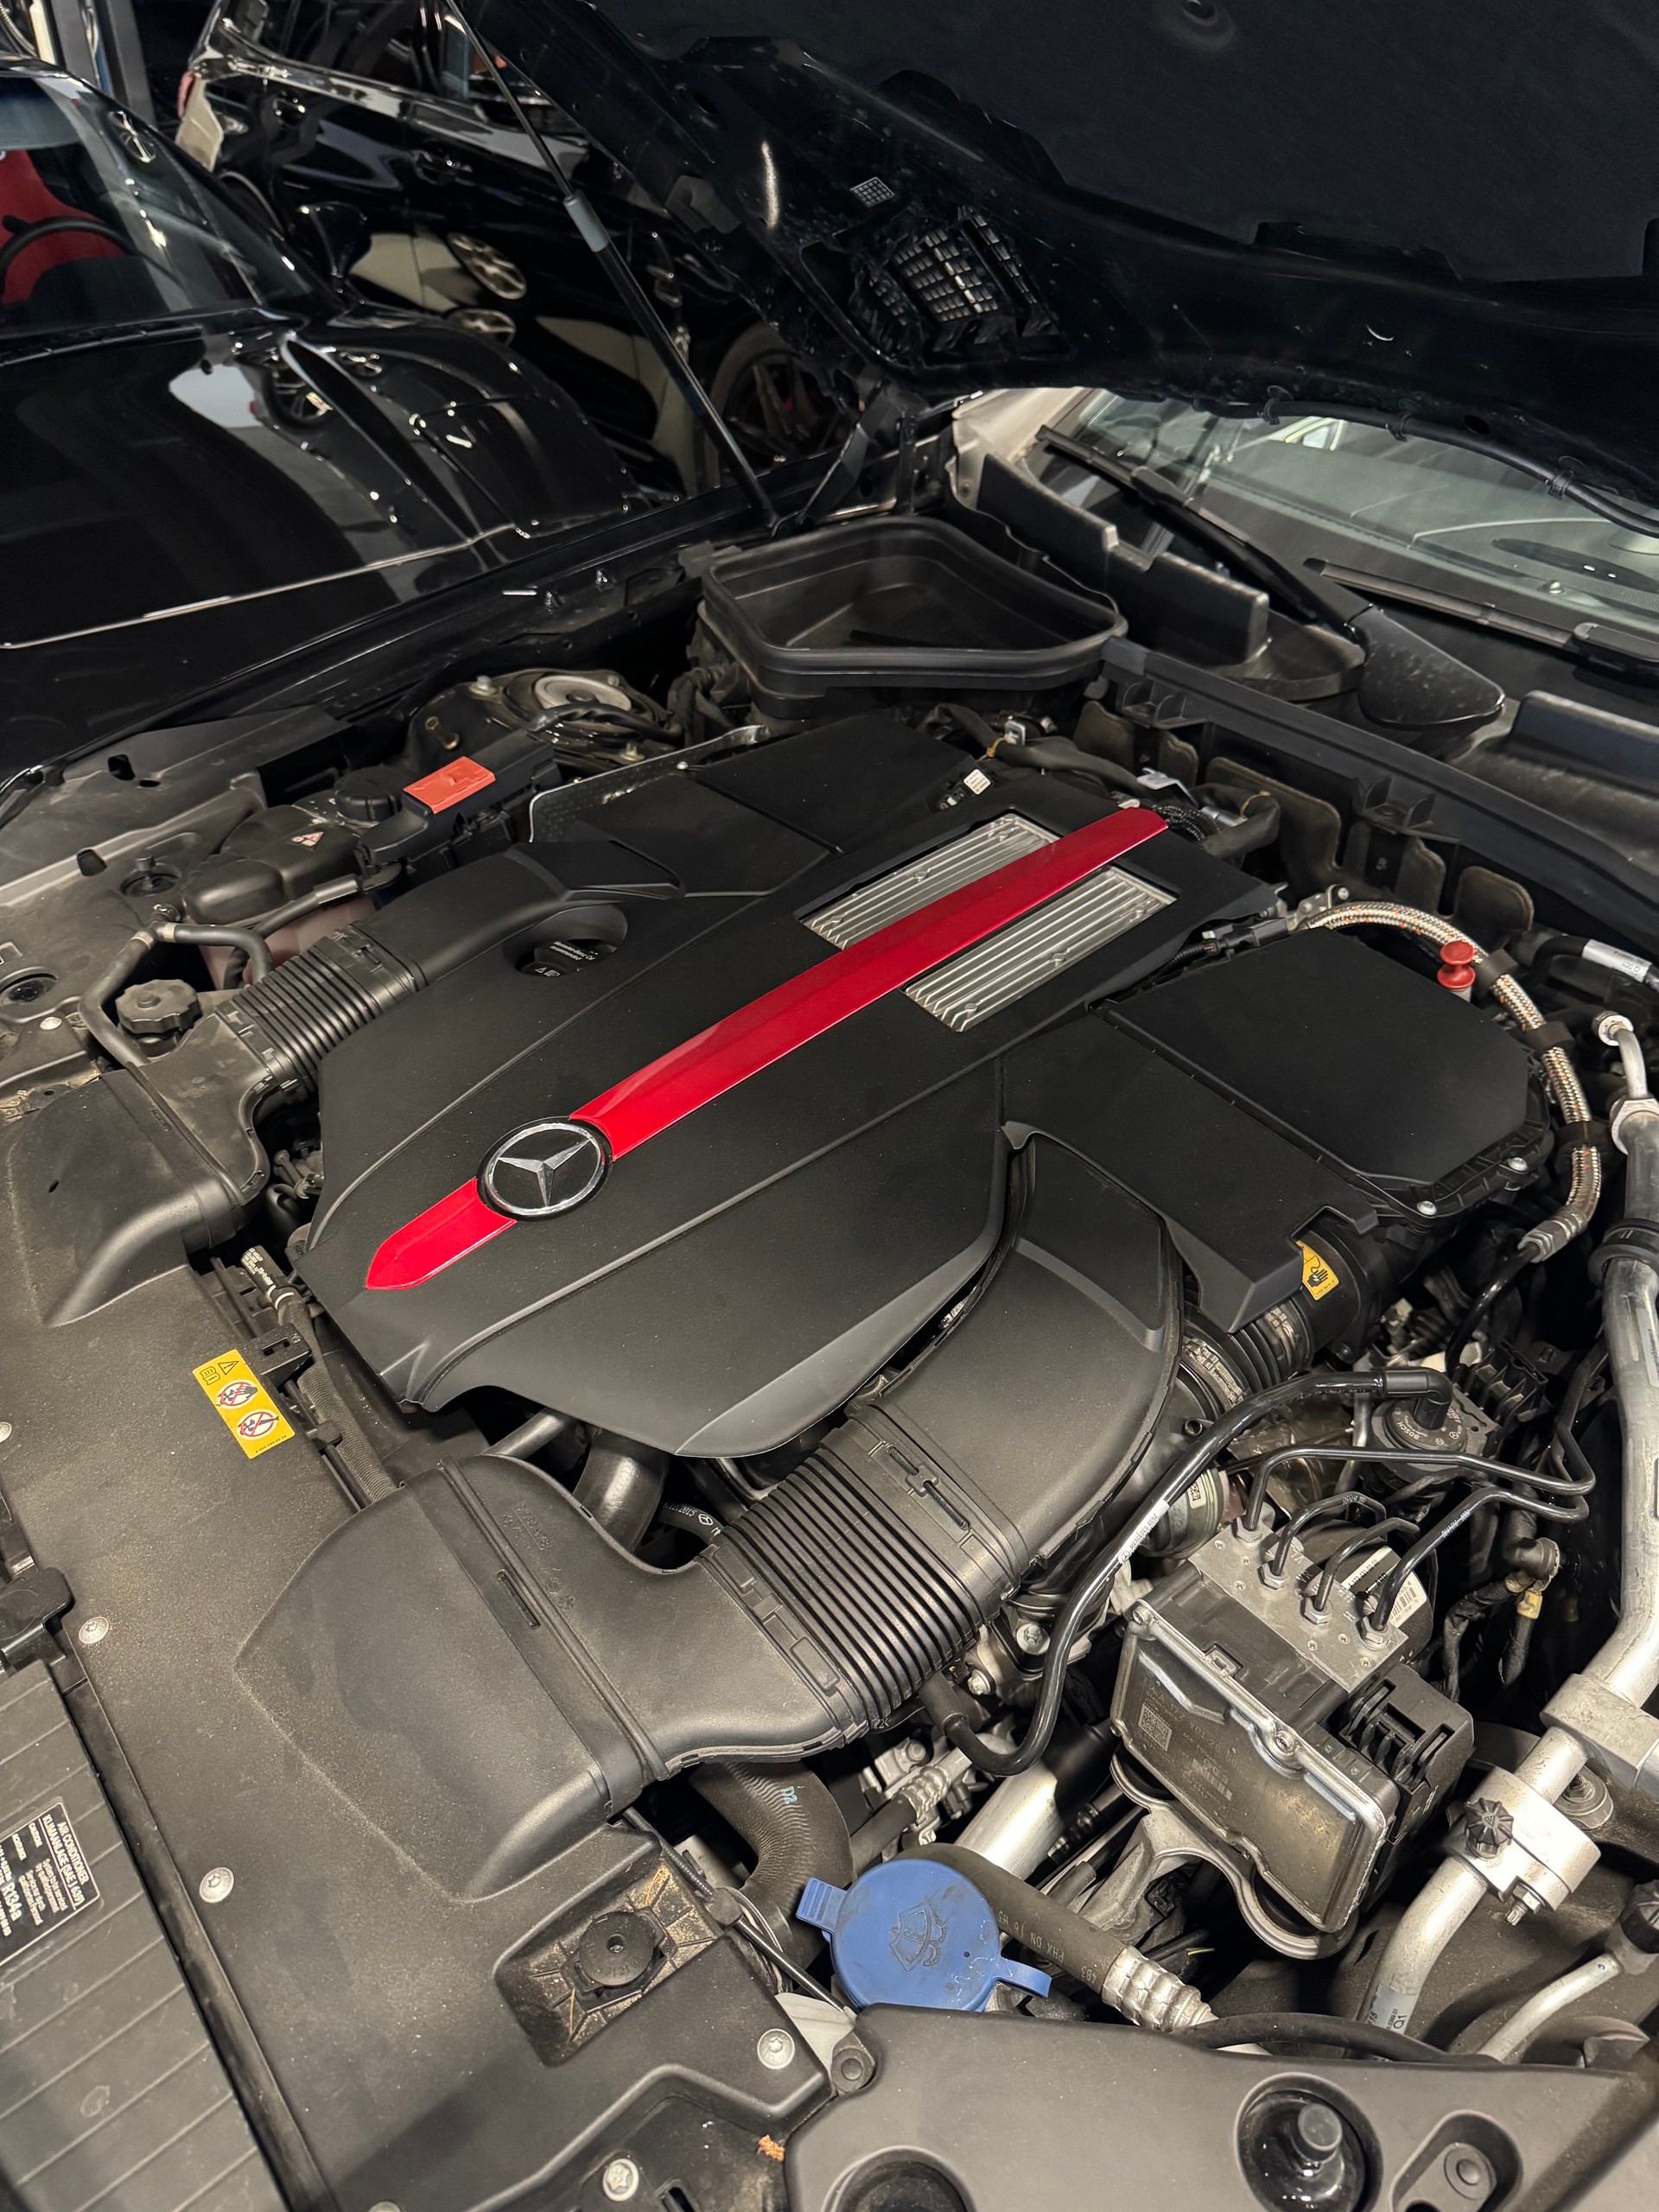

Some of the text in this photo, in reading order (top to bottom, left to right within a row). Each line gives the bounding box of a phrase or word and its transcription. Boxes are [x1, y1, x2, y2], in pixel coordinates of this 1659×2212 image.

[1396, 1421, 1419, 1440] BOSCH
[781, 1785, 798, 1803] D2
[41, 1814, 69, 1866] KLIMAANLAGE
[60, 1863, 75, 1884] (SAE
[69, 1885, 85, 1906] 639)
[58, 1821, 88, 1885] AIR CONDITIONER
[3, 1882, 22, 1921] R134a
[1030, 1932, 1043, 1948] DN
[1046, 1942, 1065, 1964] PHX
[1393, 2013, 1407, 2029] Q1
